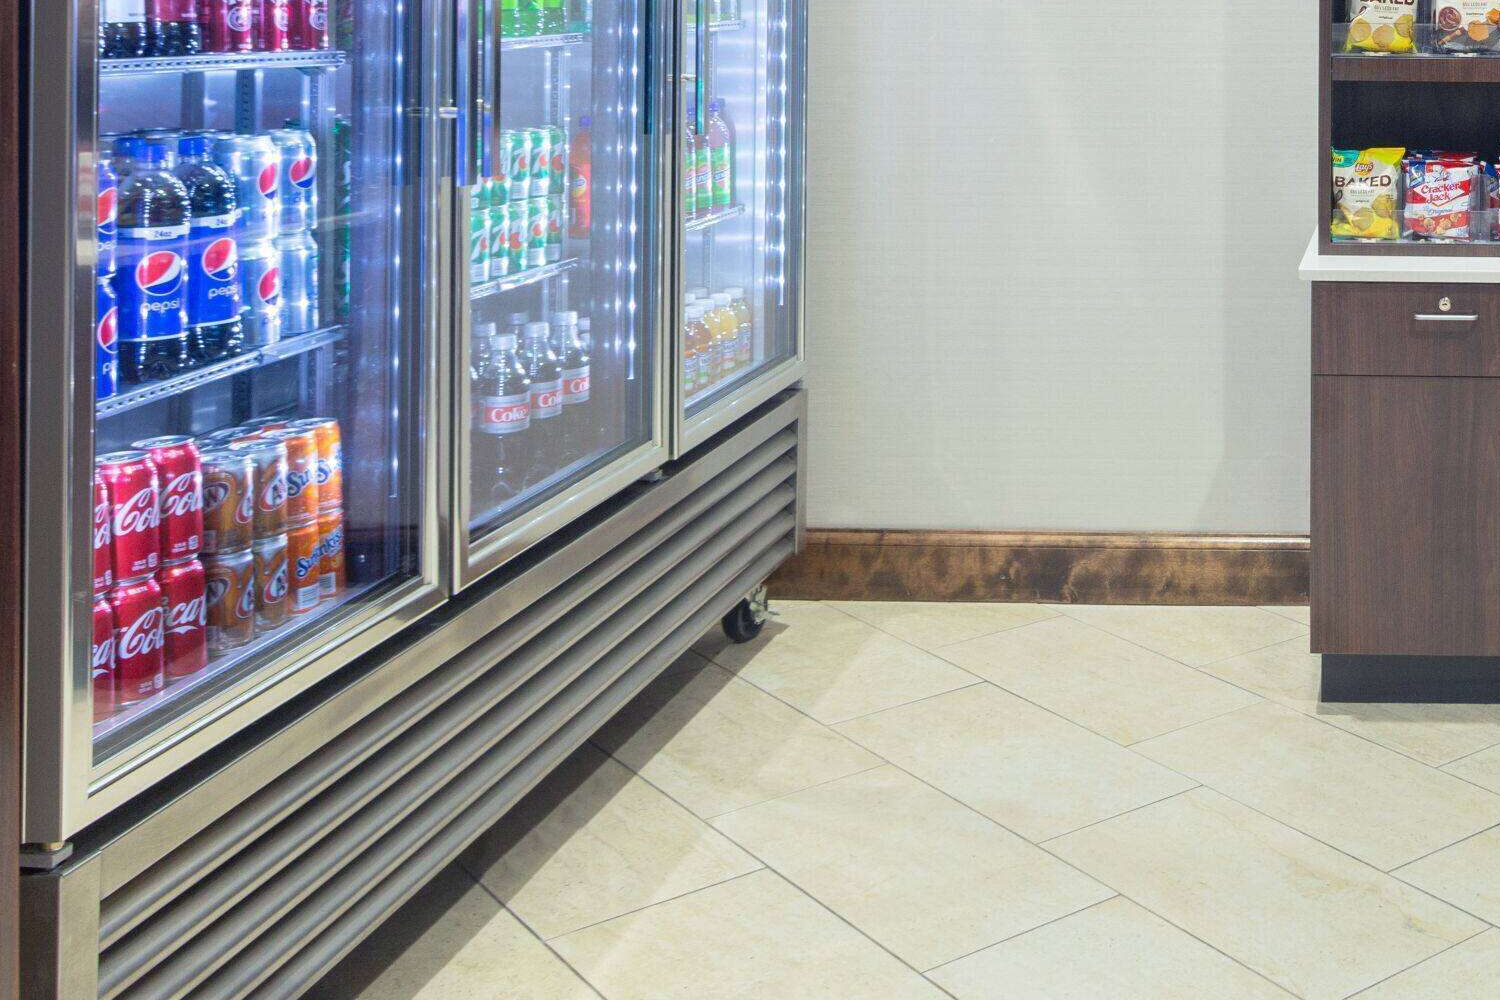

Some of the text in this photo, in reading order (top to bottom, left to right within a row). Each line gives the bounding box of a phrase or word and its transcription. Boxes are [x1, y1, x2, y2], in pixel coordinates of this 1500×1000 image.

[1355, 162, 1375, 173] Lay's
[1335, 175, 1391, 187] BAKED
[1421, 183, 1461, 195] Cracker
[1426, 192, 1450, 204] Jack
[140, 300, 181, 315] pepsi
[490, 404, 528, 423] Coke
